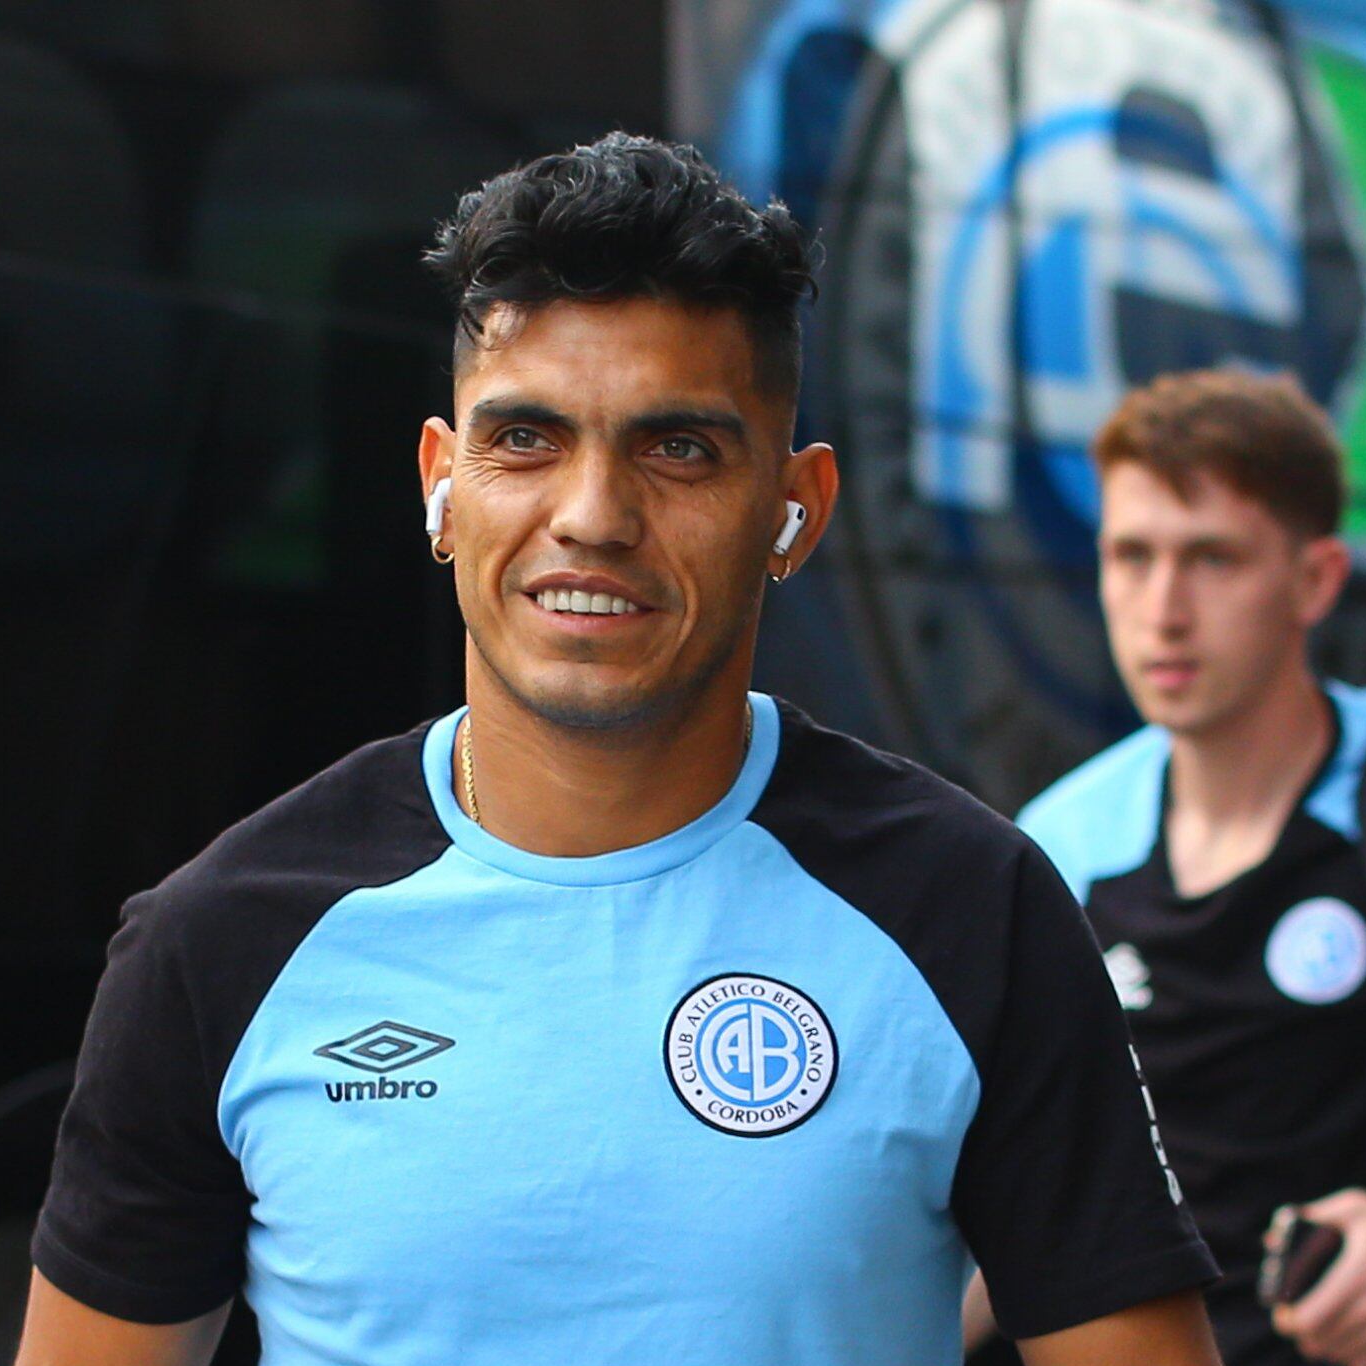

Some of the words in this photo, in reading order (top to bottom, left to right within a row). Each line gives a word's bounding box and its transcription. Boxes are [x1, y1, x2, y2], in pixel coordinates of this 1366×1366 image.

[687, 983, 766, 1028] ATLETICO
[678, 1033, 698, 1084] CLUB
[772, 991, 824, 1083] BELGRANO
[325, 1076, 438, 1103] umbro
[707, 1099, 799, 1124] CORDOBA
